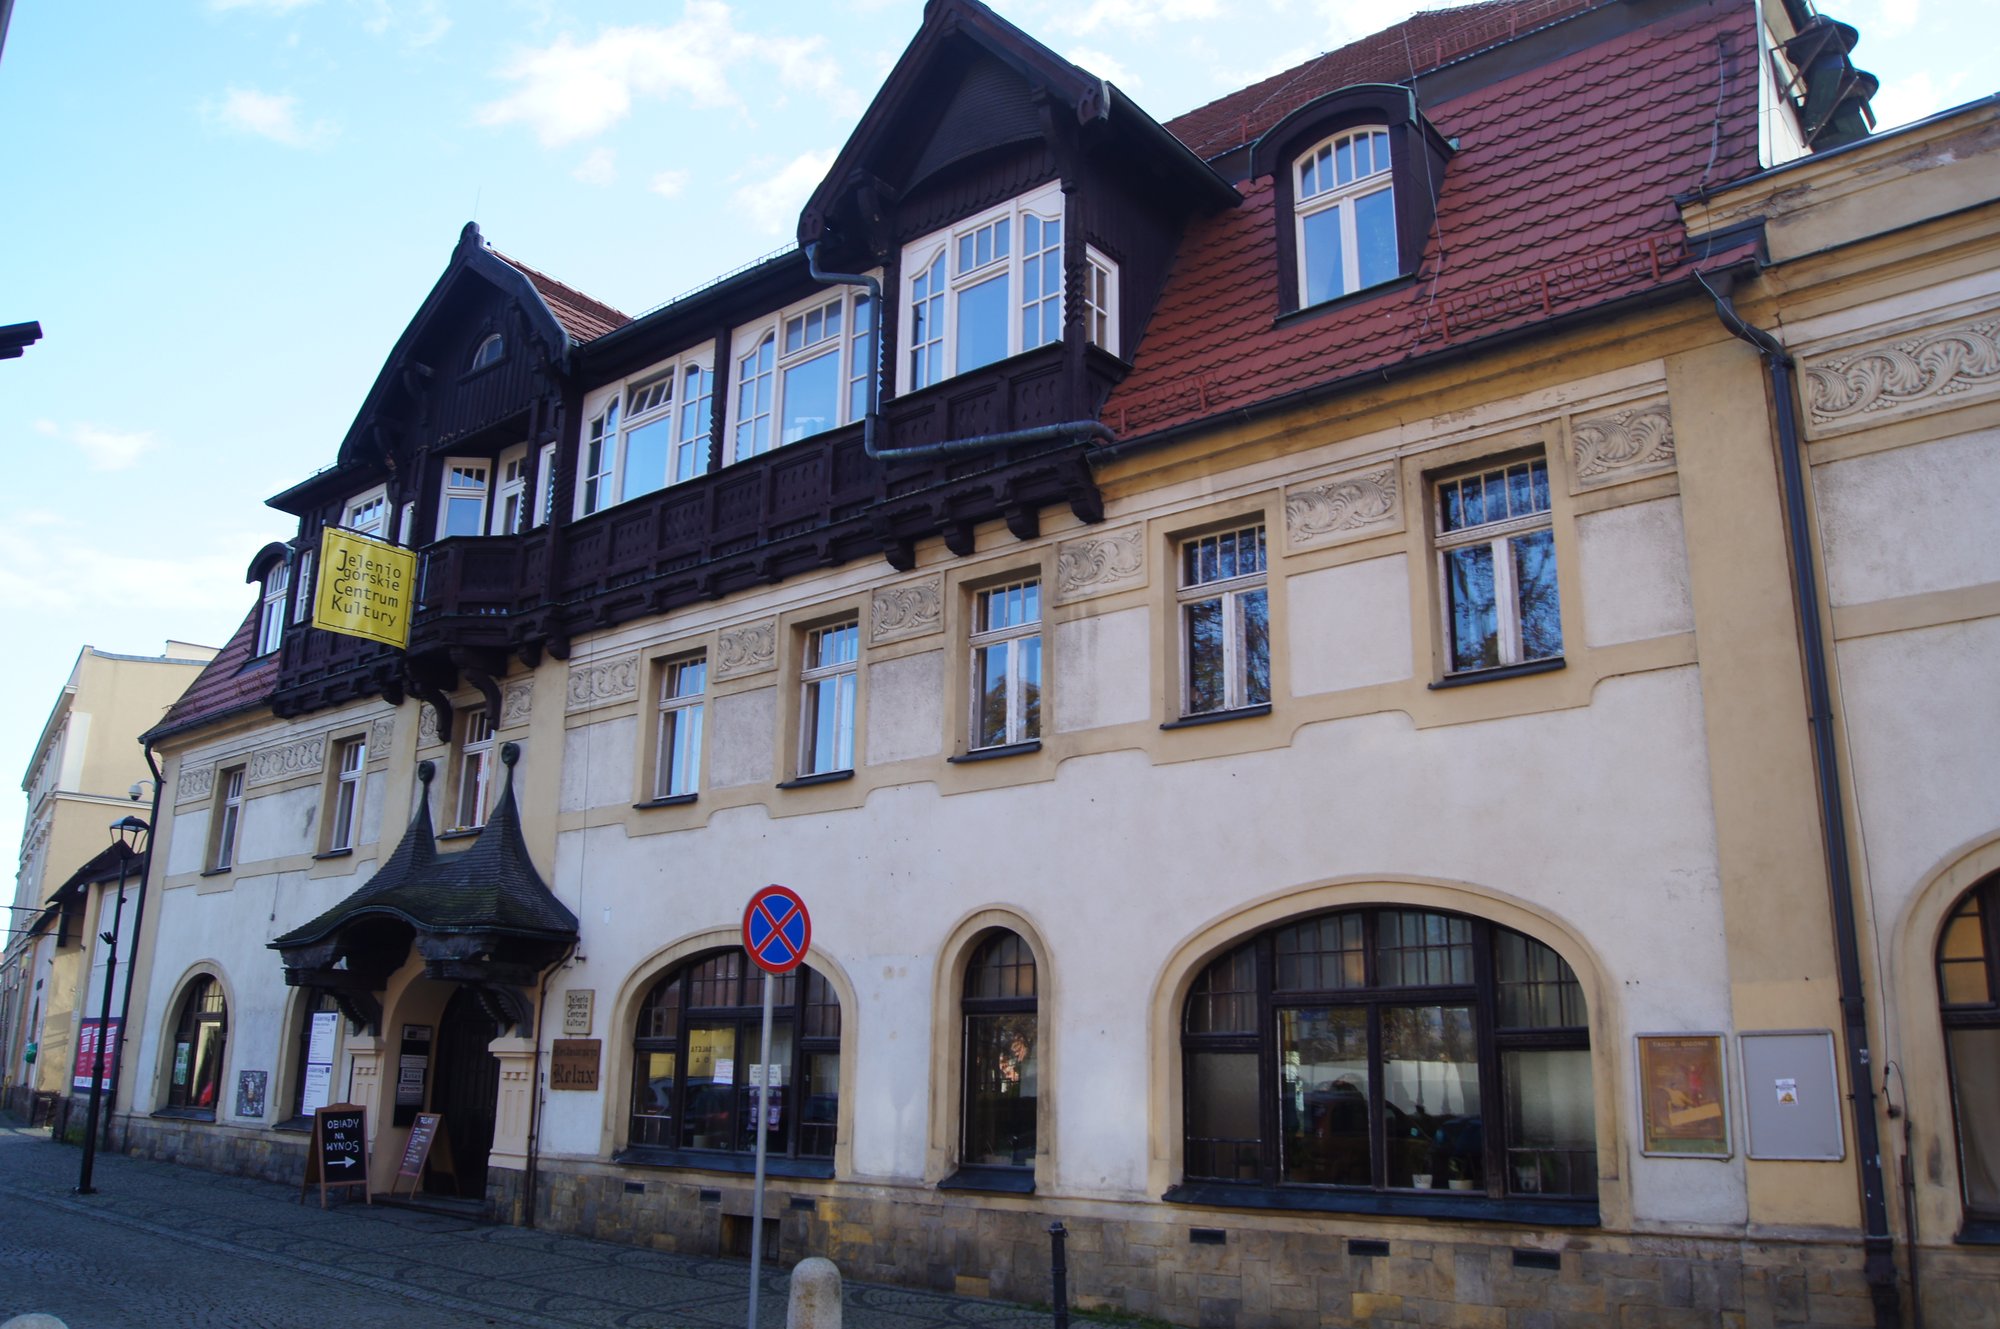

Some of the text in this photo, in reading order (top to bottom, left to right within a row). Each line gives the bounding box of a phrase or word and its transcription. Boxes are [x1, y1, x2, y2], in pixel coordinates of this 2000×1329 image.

[336, 549, 402, 579] Jelenio
[343, 567, 400, 592] górskie
[333, 578, 398, 608] Centrum
[331, 594, 397, 627] Kultury
[567, 1009, 587, 1018] Centrum
[553, 1063, 595, 1084] Relax
[327, 1118, 360, 1129] OBIADY
[325, 1140, 360, 1153] WYNOS
[334, 1132, 345, 1140] NA
